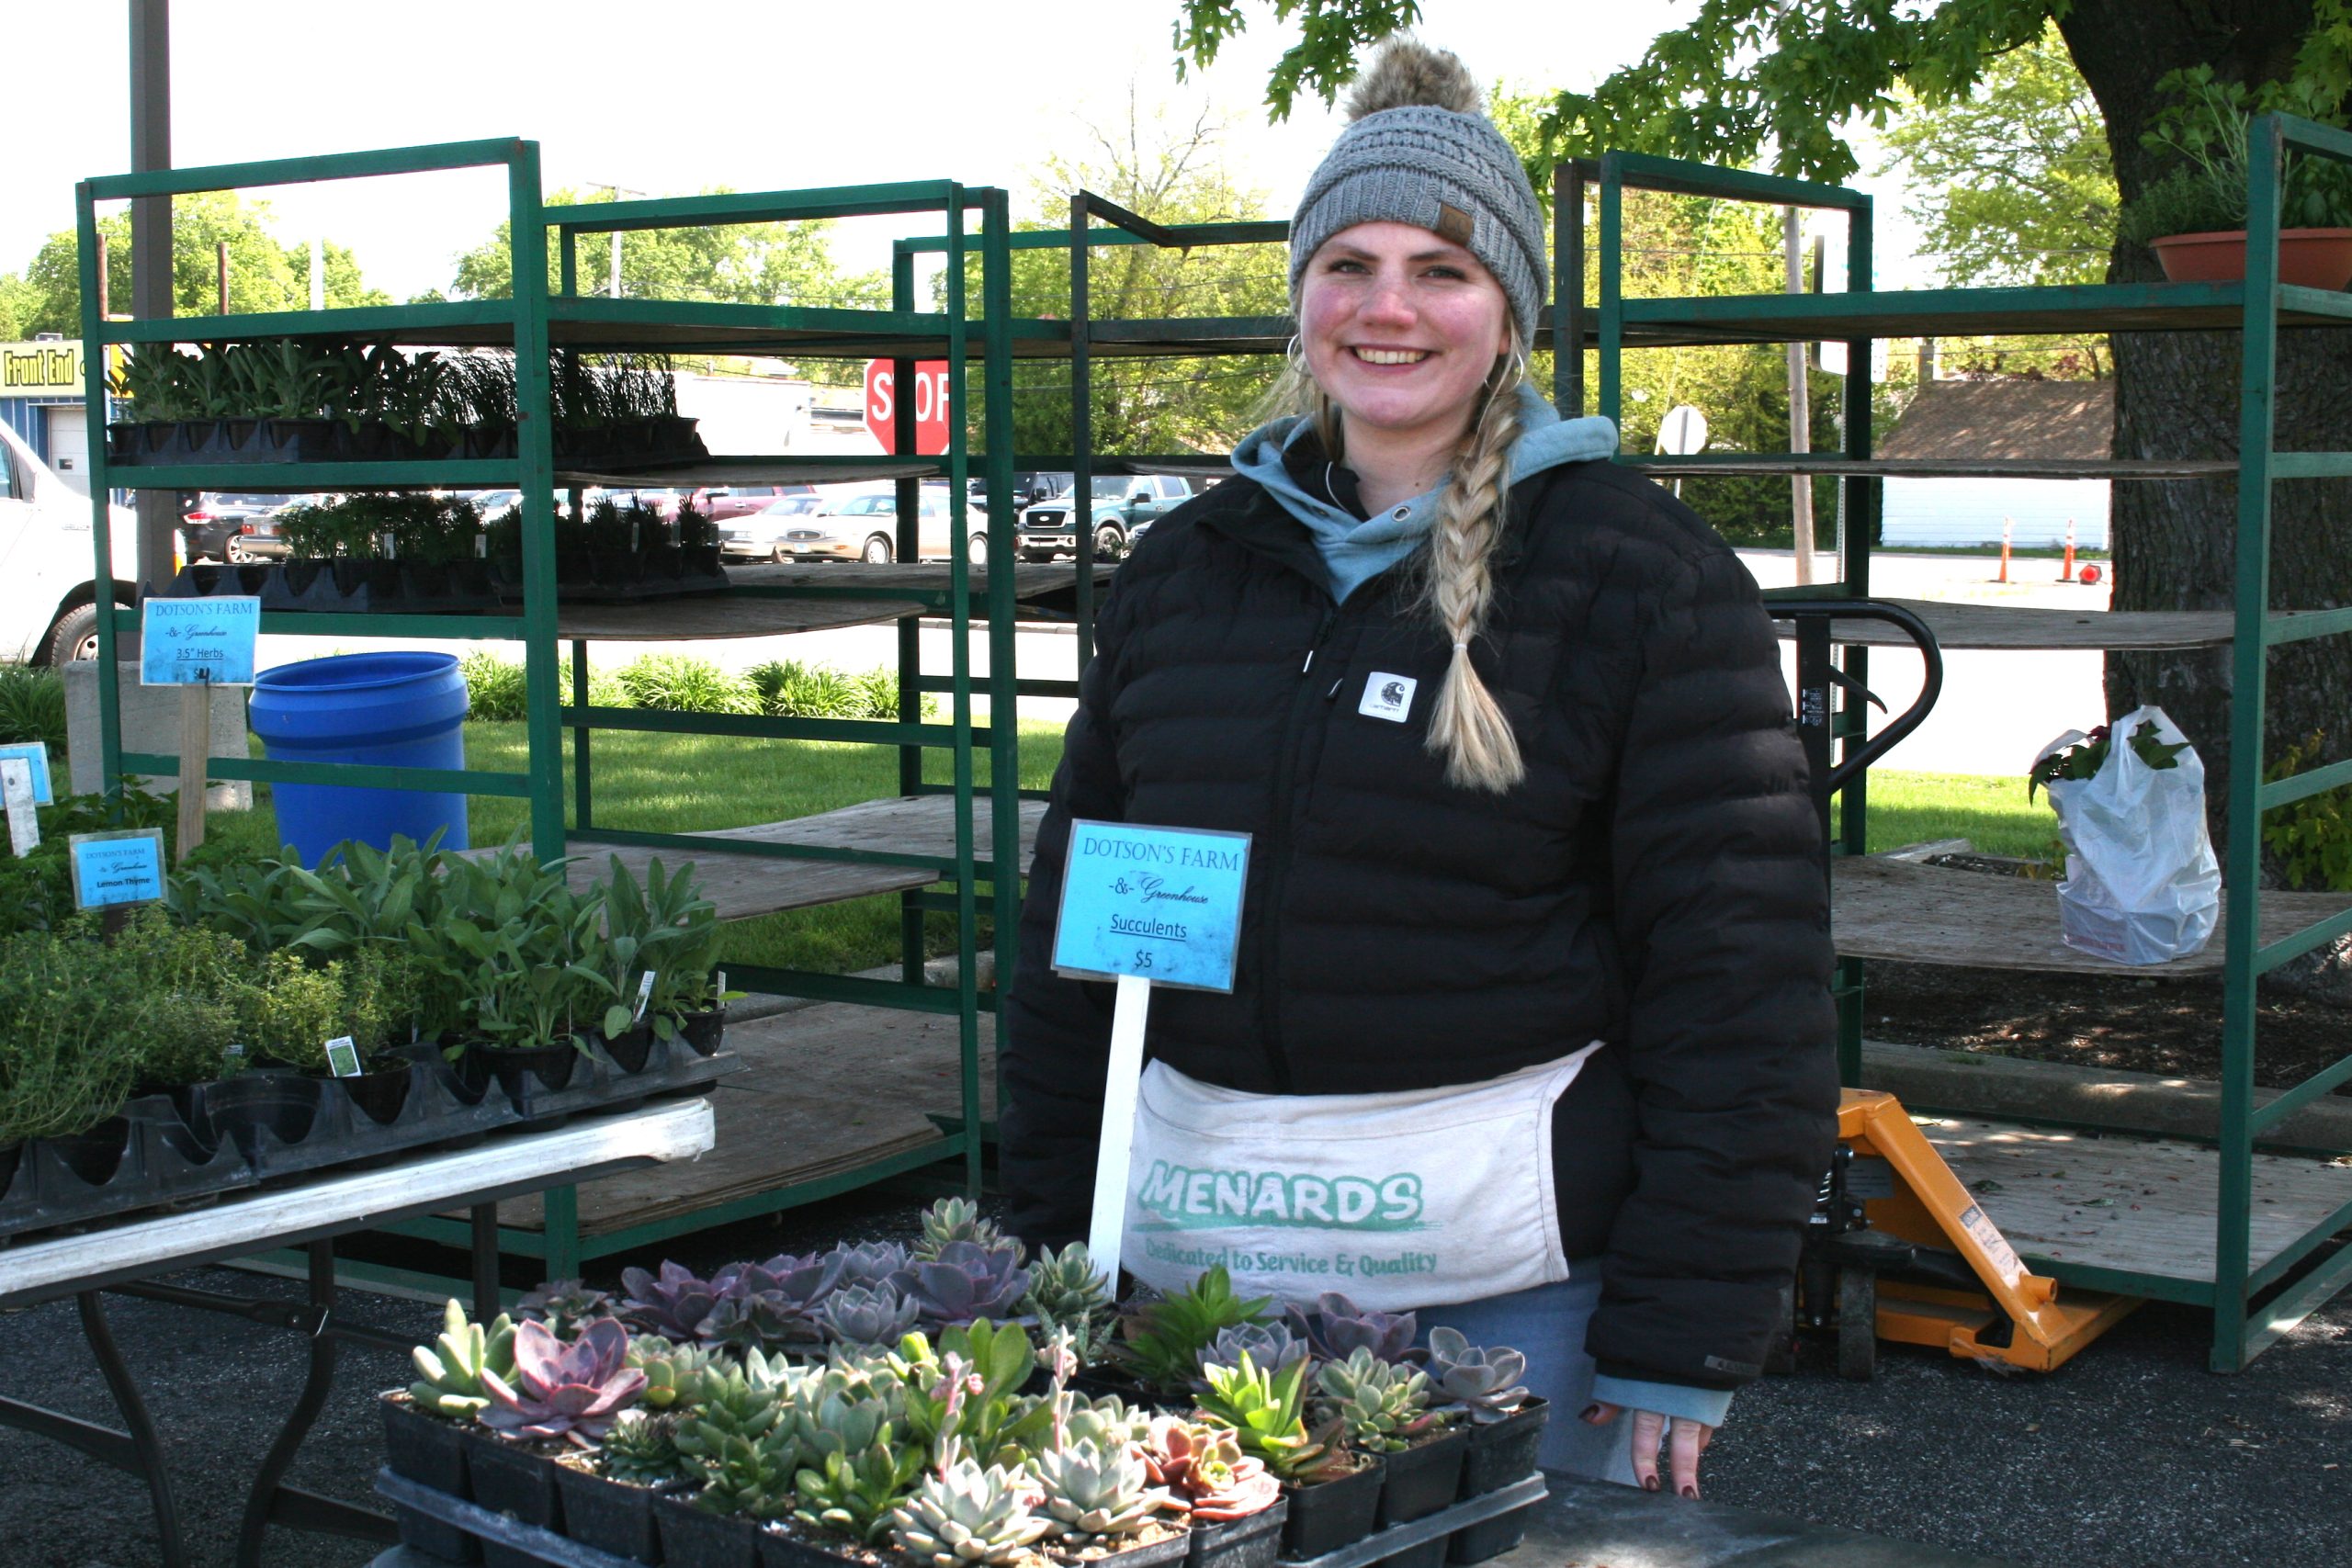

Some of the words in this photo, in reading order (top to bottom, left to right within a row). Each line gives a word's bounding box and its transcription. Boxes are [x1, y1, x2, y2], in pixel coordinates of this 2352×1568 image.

[4, 350, 45, 386] Front
[47, 348, 74, 386] End
[155, 604, 213, 616] DOTSON'S
[216, 603, 253, 615] FARM
[197, 648, 224, 659] Herbs
[1083, 837, 1176, 864] DOTSON'S
[1181, 847, 1239, 872] FARM
[96, 879, 123, 888] Lemon
[124, 877, 151, 886] Thyme
[1139, 876, 1209, 905] Greenhouse
[1110, 913, 1188, 939] Succulents
[1134, 949, 1153, 969] $5
[1139, 1159, 1423, 1224] MENARDS
[1232, 1250, 1253, 1271] to
[1256, 1251, 1329, 1274] Service
[1359, 1251, 1438, 1278] Quality
